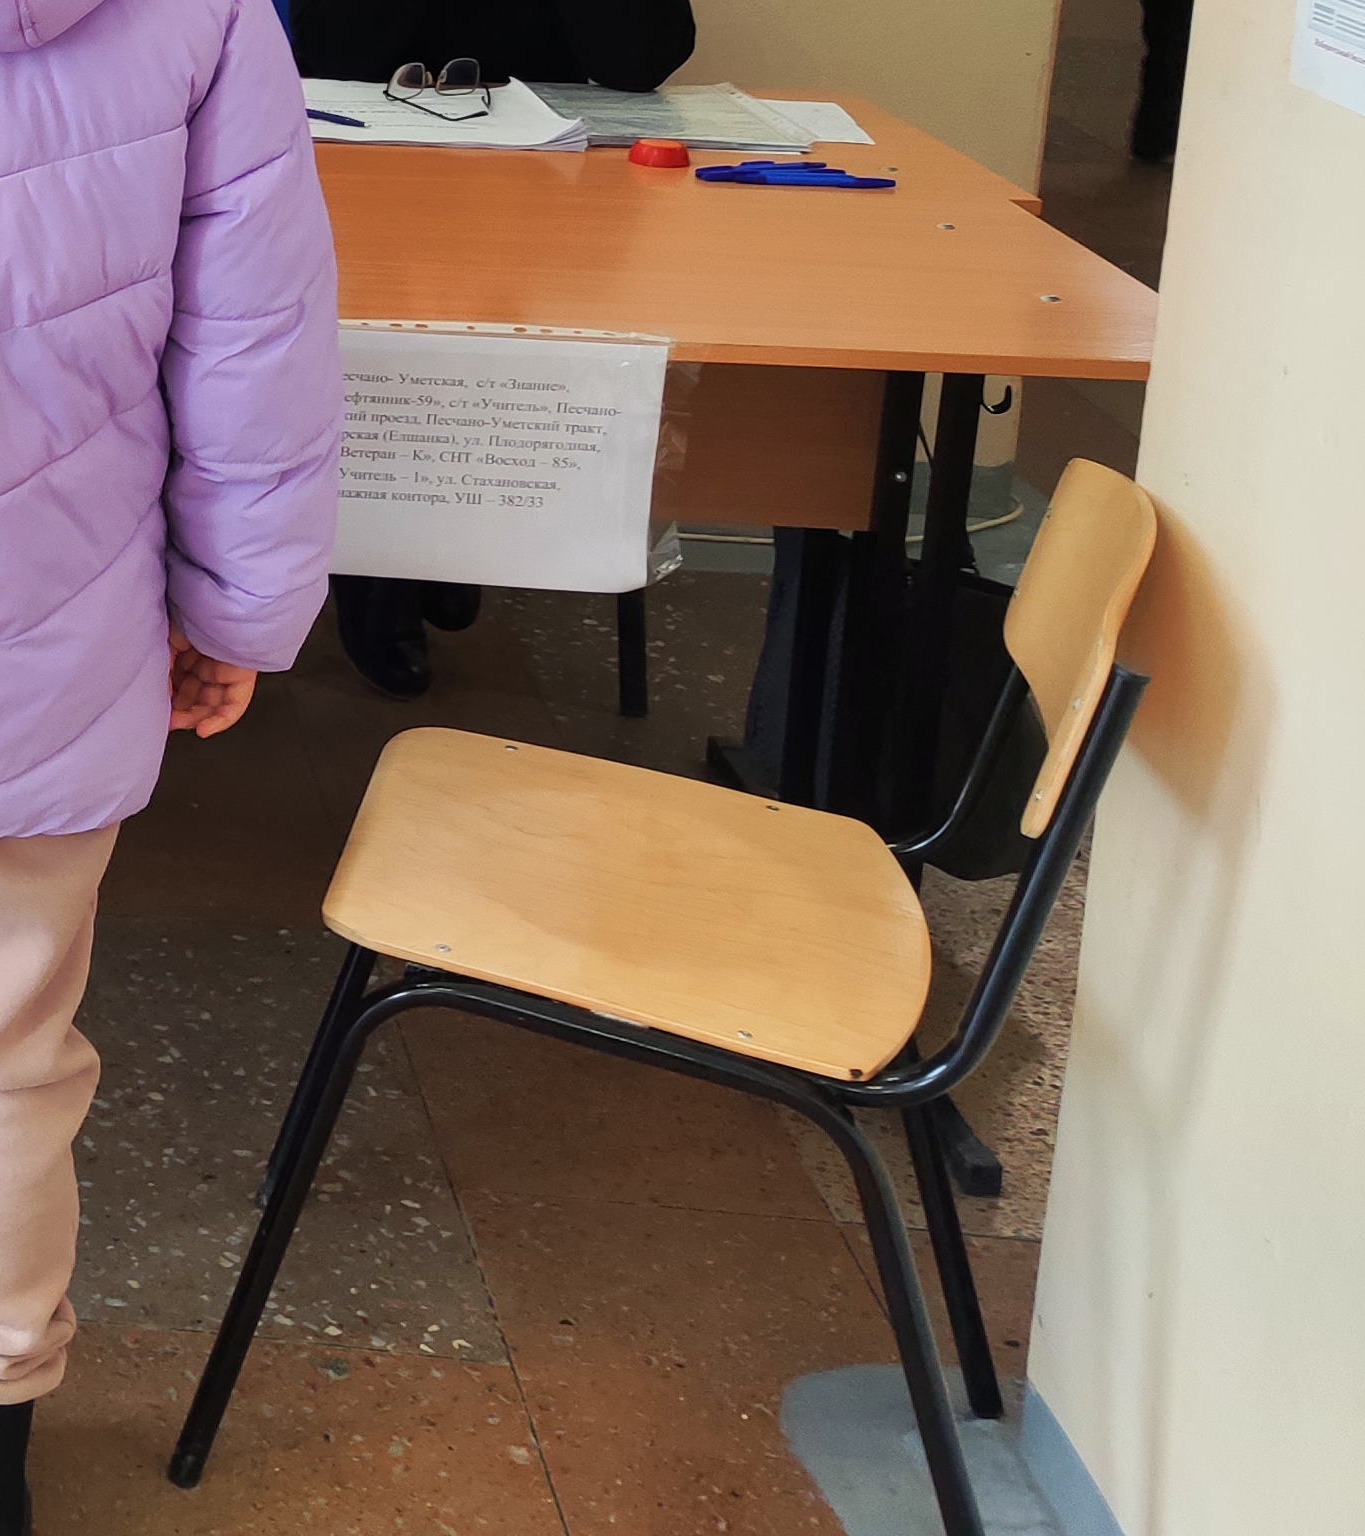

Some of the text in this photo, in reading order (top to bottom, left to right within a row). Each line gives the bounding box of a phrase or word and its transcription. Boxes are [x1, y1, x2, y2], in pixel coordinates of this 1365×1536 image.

[342, 373, 393, 383] есчано-
[344, 391, 445, 408] ефтянник-59»,
[556, 402, 623, 416] Песчано-
[341, 429, 379, 442] рская
[439, 450, 473, 463] СНТ
[337, 489, 387, 500] нажная
[454, 492, 482, 505] УШ
